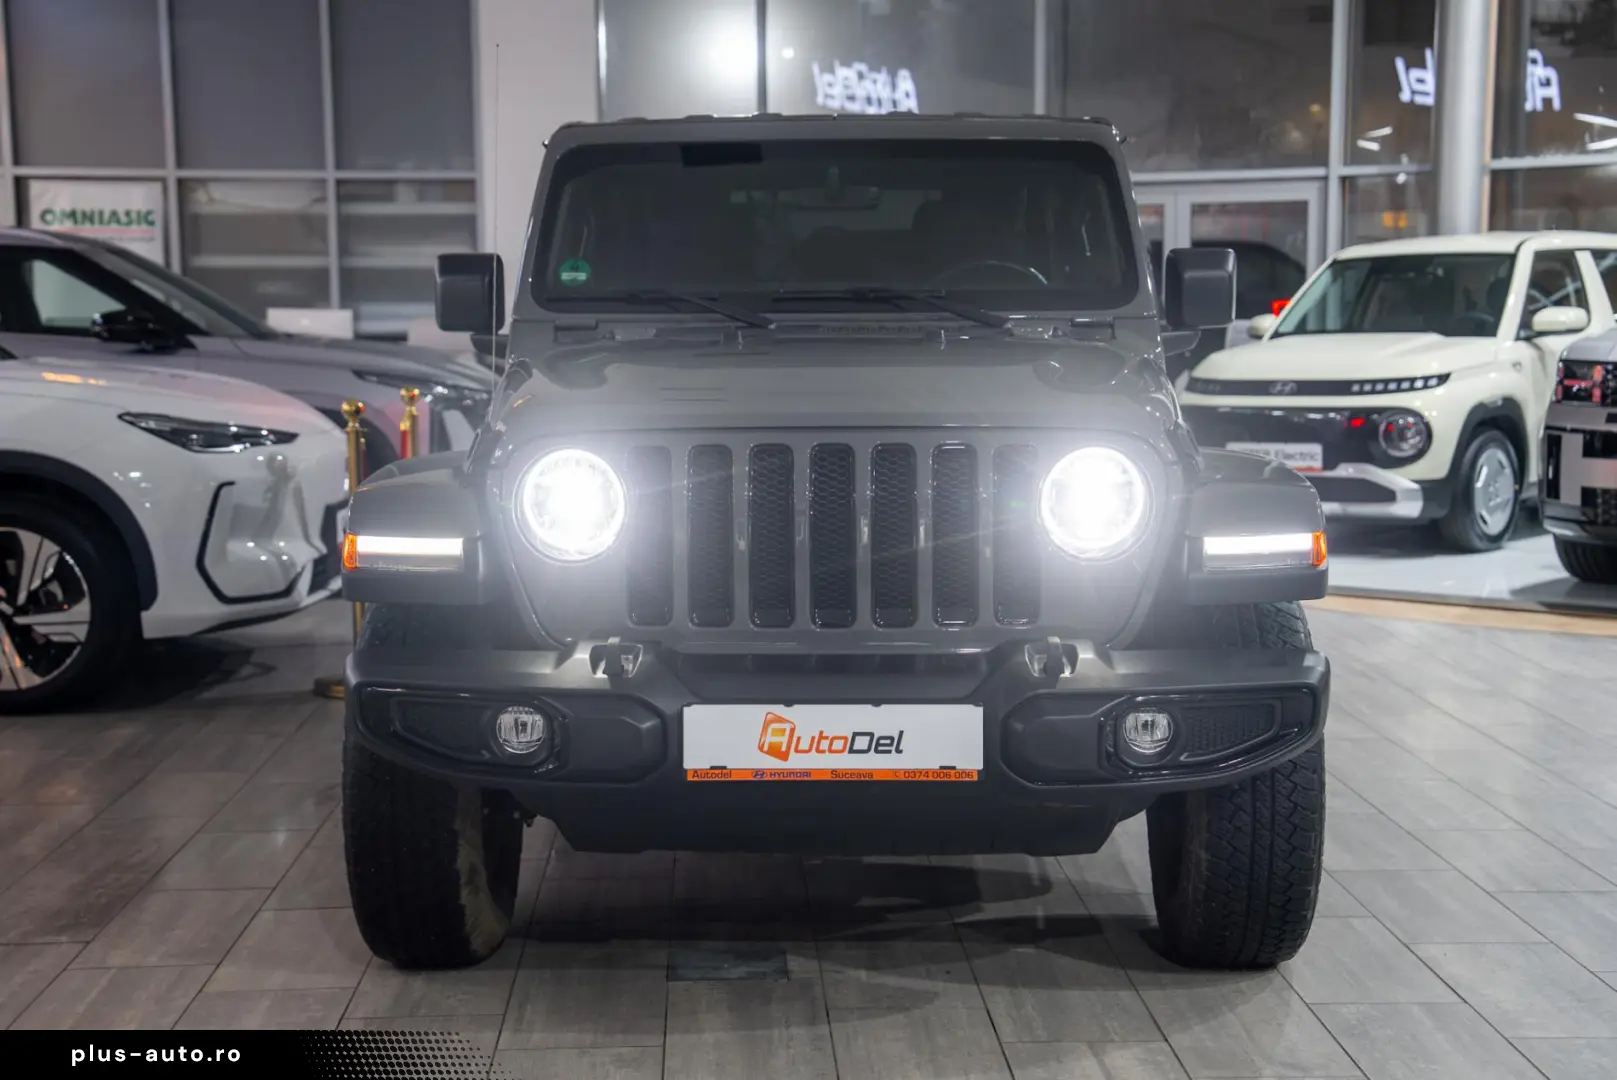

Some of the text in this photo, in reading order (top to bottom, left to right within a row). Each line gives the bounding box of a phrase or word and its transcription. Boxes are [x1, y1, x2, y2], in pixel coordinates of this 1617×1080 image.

[39, 208, 156, 227] OMNIASIG
[758, 712, 904, 762] AutoDel
[691, 770, 732, 779] Autodel
[830, 770, 874, 779] Suceava
[903, 771, 930, 779] 0374
[931, 771, 952, 779] 006
[954, 771, 974, 779] 006
